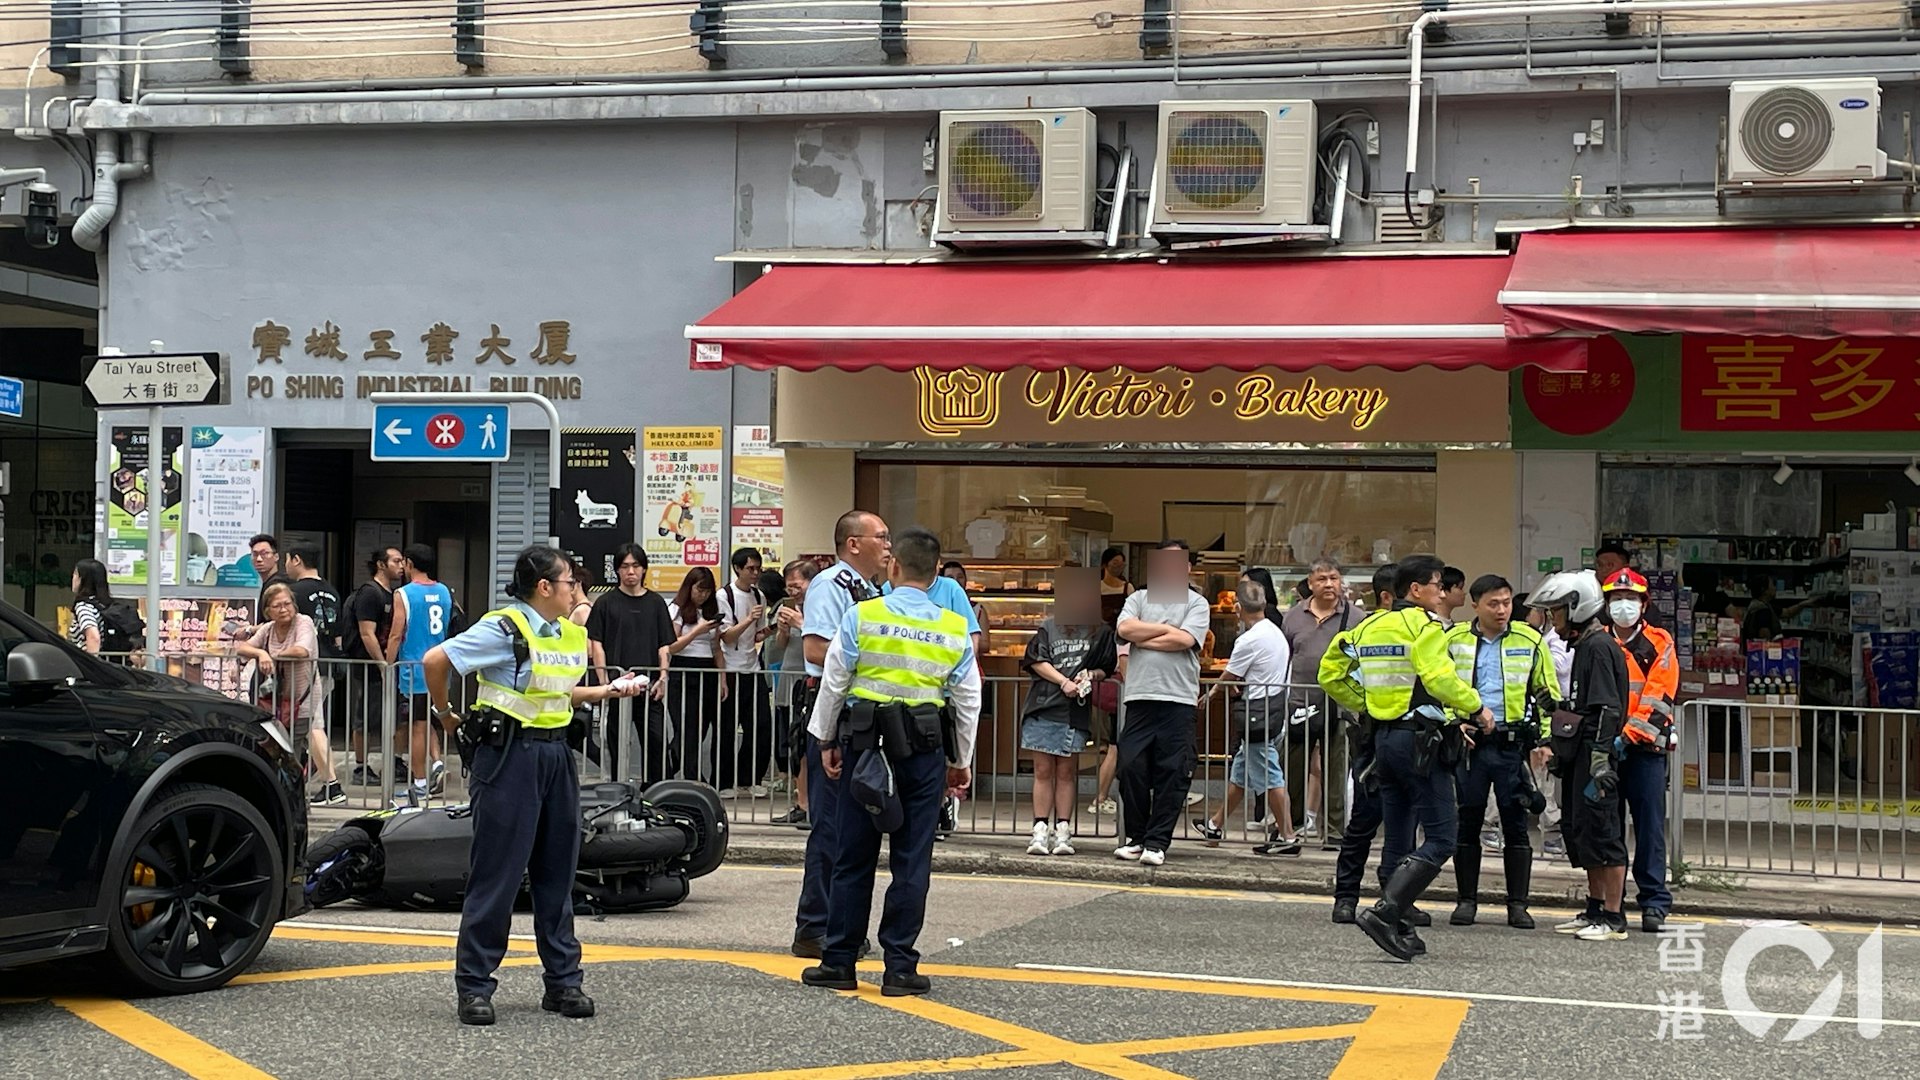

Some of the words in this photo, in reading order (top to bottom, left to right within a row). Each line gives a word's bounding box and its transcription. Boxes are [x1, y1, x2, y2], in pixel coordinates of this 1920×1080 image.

[104, 362, 123, 375] Tai
[127, 361, 152, 374] Yau
[156, 360, 198, 373] Street
[123, 382, 178, 399] 大有街
[186, 384, 199, 393] 23
[247, 375, 274, 399] PO
[285, 375, 344, 399] SHING
[1702, 339, 1920, 422] 喜多
[1025, 367, 1195, 424] Victori
[1234, 375, 1389, 430] Bakery
[429, 604, 443, 635] 8
[894, 626, 931, 642] POLICE
